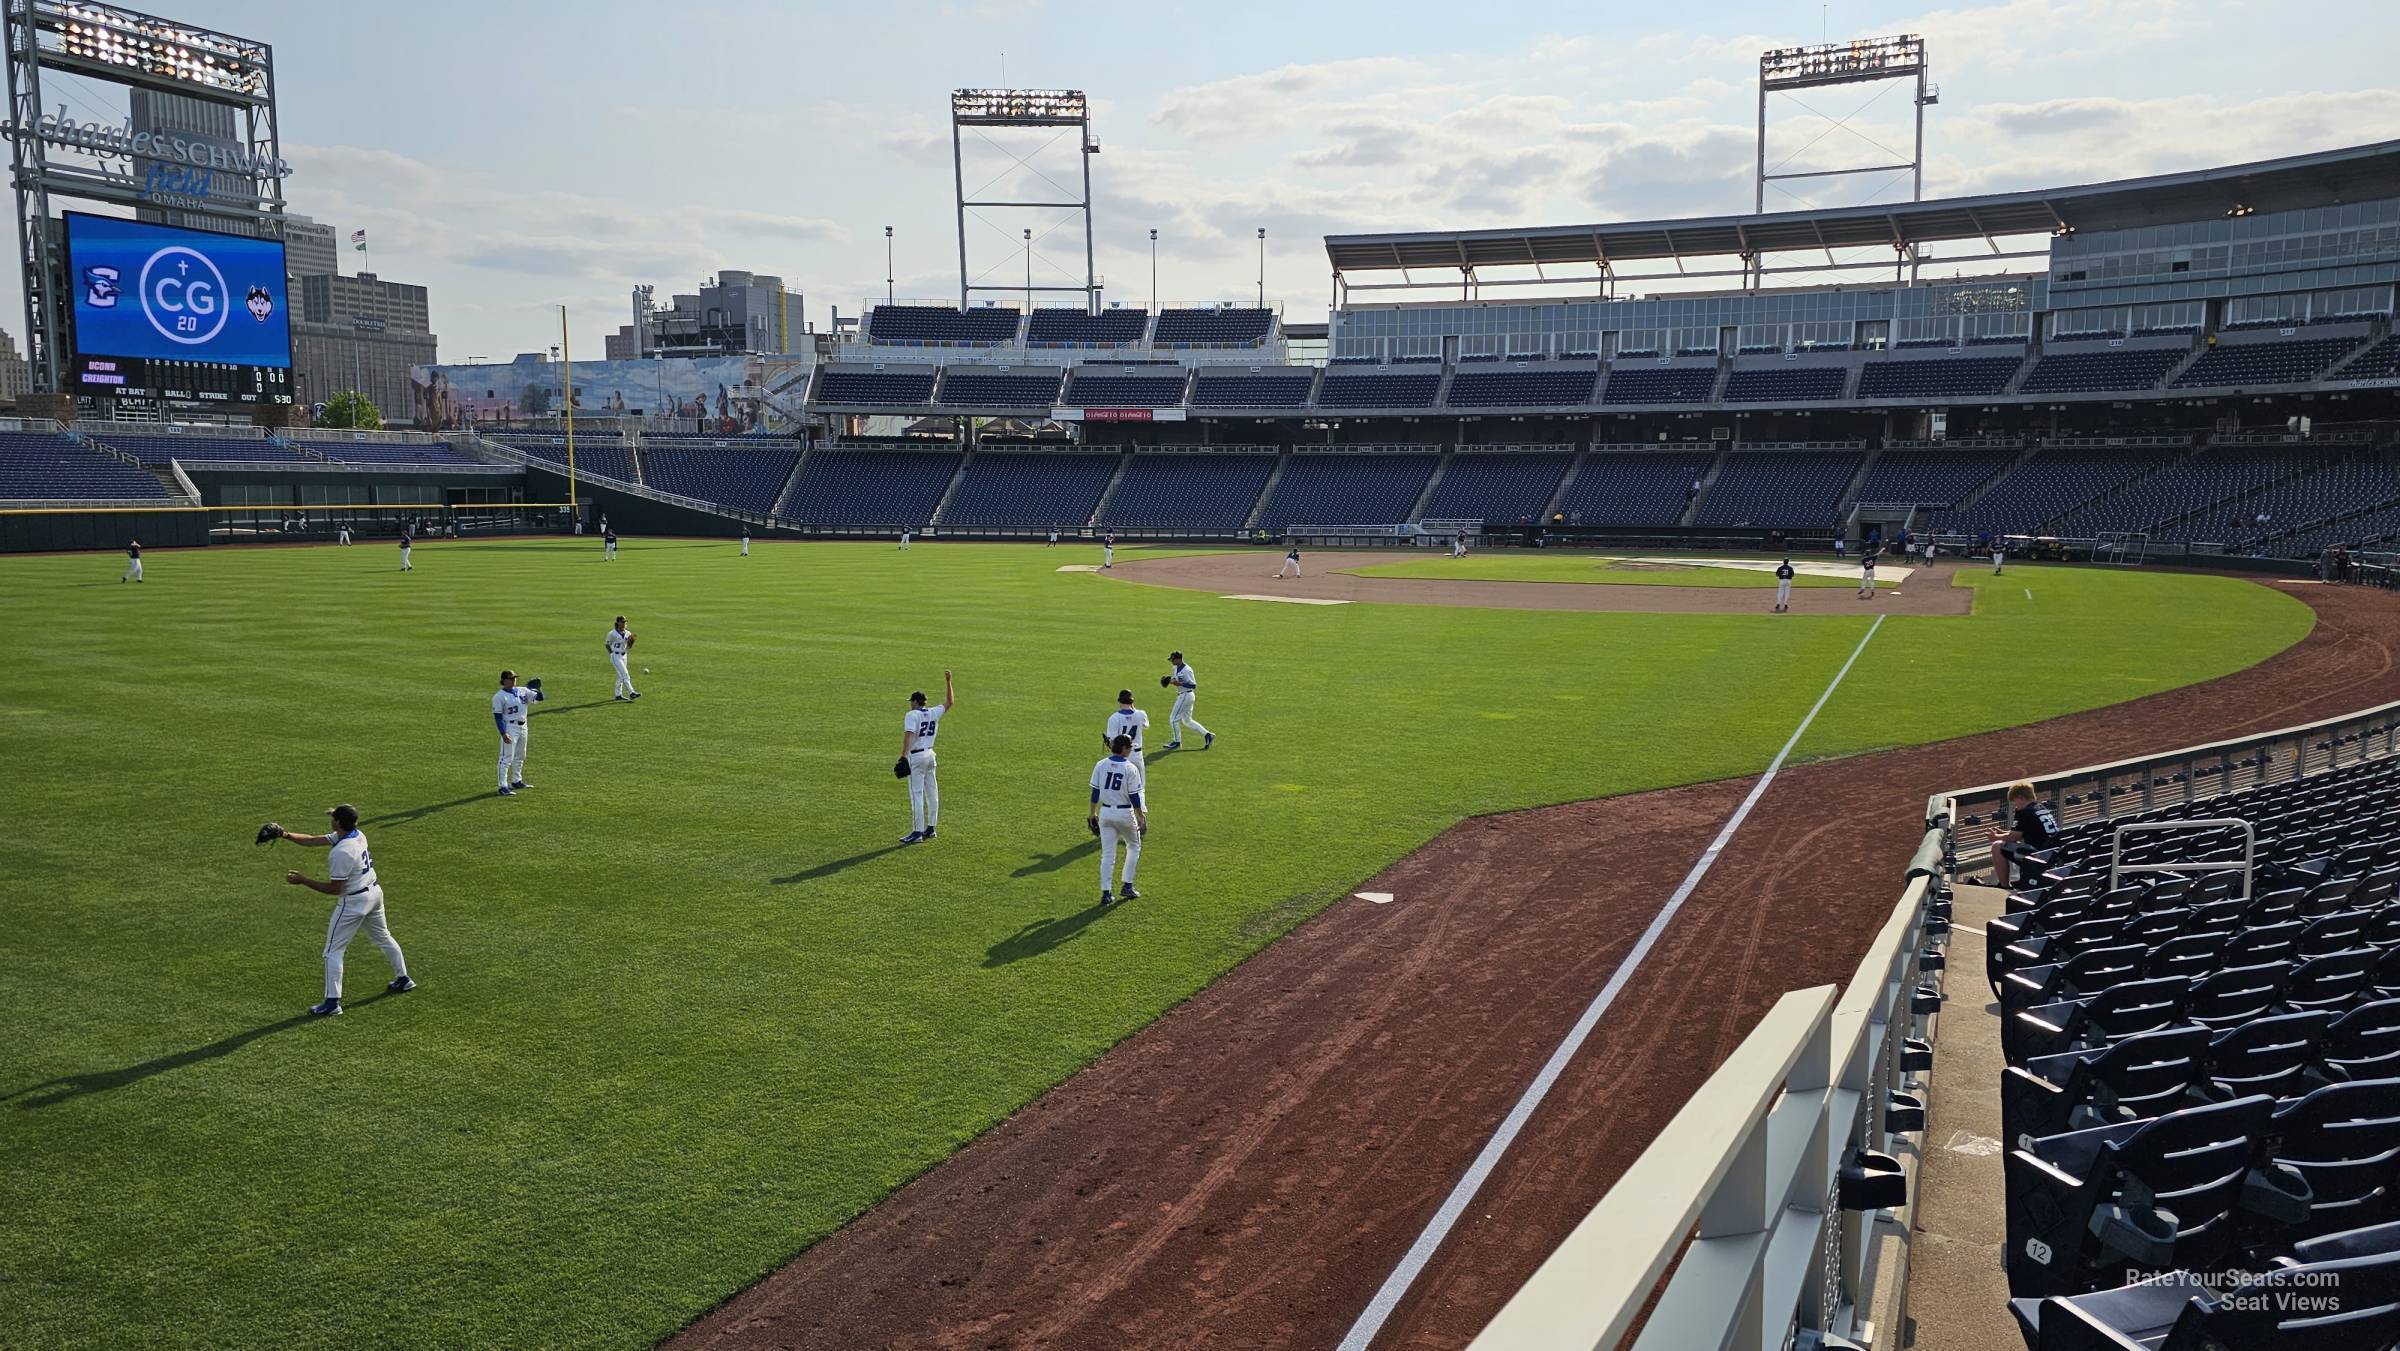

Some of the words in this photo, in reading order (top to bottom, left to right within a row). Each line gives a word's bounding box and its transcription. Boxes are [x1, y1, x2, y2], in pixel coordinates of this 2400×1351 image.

[34, 104, 166, 157] charles
[172, 140, 292, 179] SCHWAB
[136, 161, 213, 198] field
[152, 192, 206, 209] OMAHA
[155, 277, 215, 315] CG
[177, 316, 198, 331] 20
[88, 361, 116, 371] UCONN
[256, 371, 262, 382] 0
[269, 372, 276, 383] 0
[278, 373, 285, 383] 0
[82, 373, 124, 384] CREIGHTON
[256, 382, 263, 393] 0
[115, 387, 127, 395] AT
[128, 388, 145, 396] BAT
[165, 390, 185, 398] BALL
[199, 392, 228, 400] STRIKE
[241, 394, 256, 402] OUT
[274, 394, 292, 404] 5:30
[507, 705, 519, 715] 33
[919, 720, 936, 737] 29
[1104, 771, 1124, 791] 16
[2032, 1243, 2047, 1260] 12
